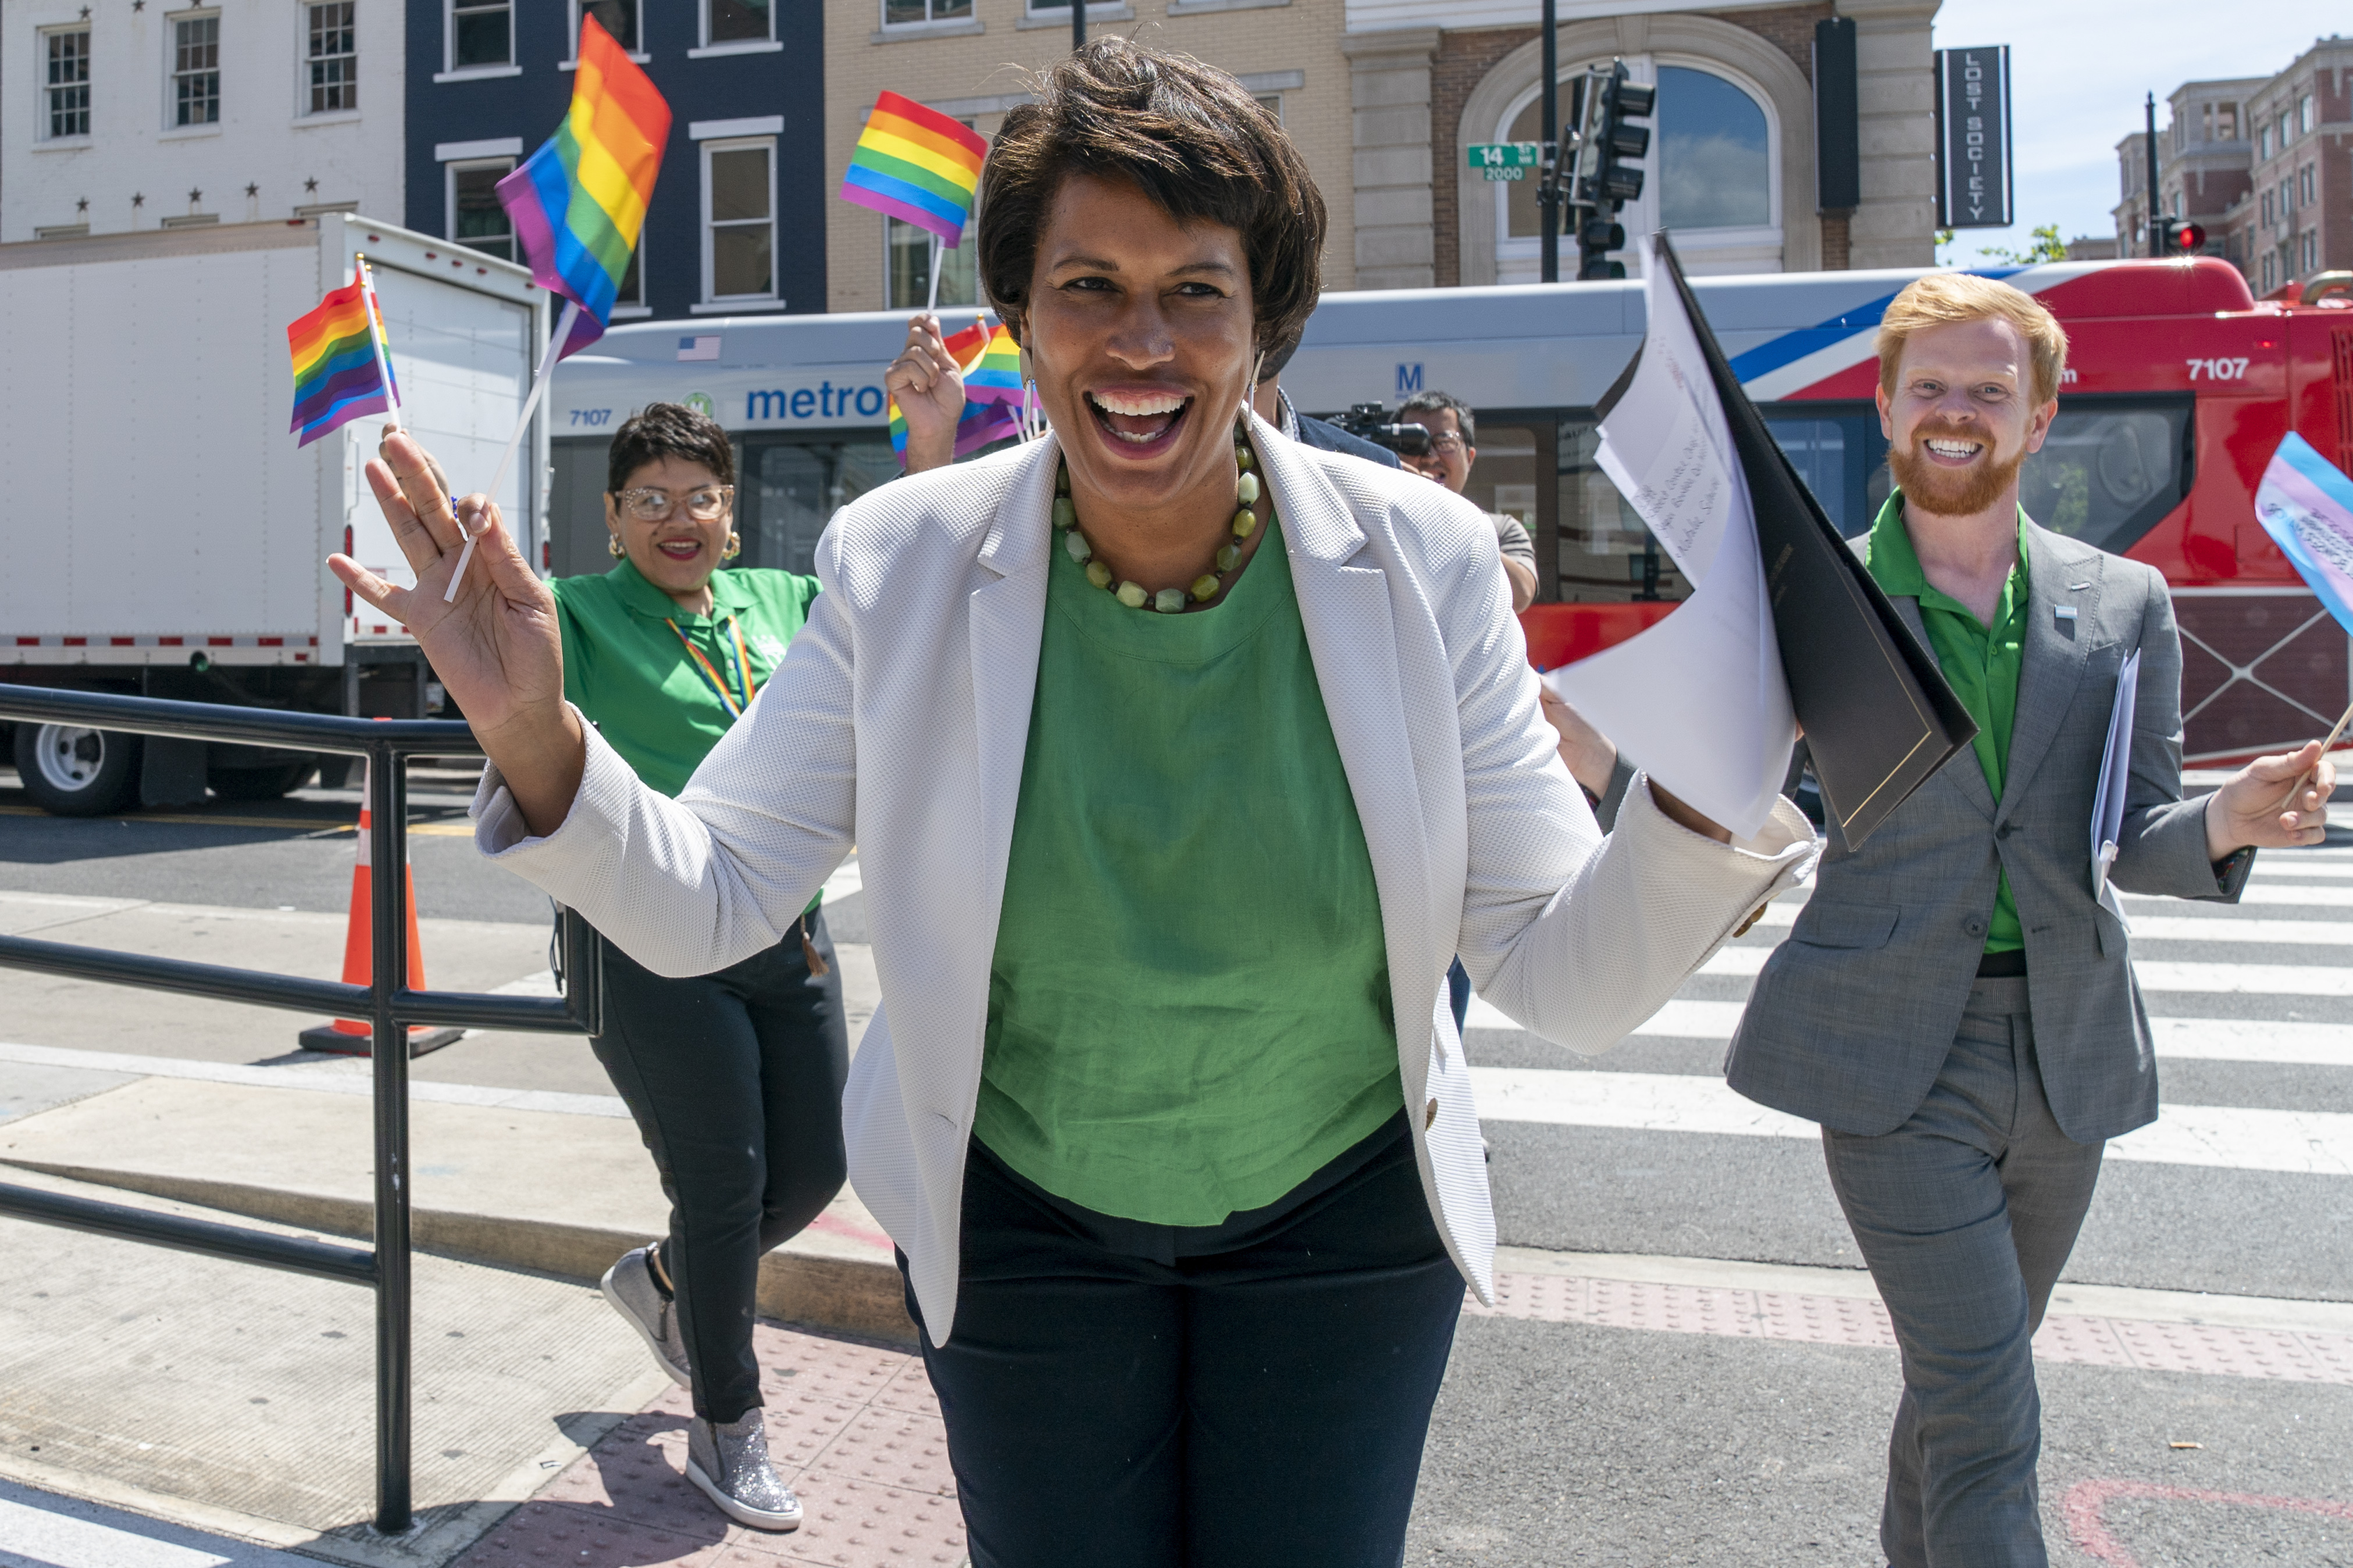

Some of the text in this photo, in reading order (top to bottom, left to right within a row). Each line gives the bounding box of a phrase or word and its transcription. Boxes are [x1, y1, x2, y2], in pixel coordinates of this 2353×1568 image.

[1965, 52, 1984, 220] LOST SOCIETY
[1479, 147, 1503, 166] 14
[1486, 166, 1523, 180] 2000
[1399, 365, 1421, 390] M
[2187, 358, 2249, 380] 7107
[747, 381, 890, 420] metro
[571, 409, 611, 426] 7107
